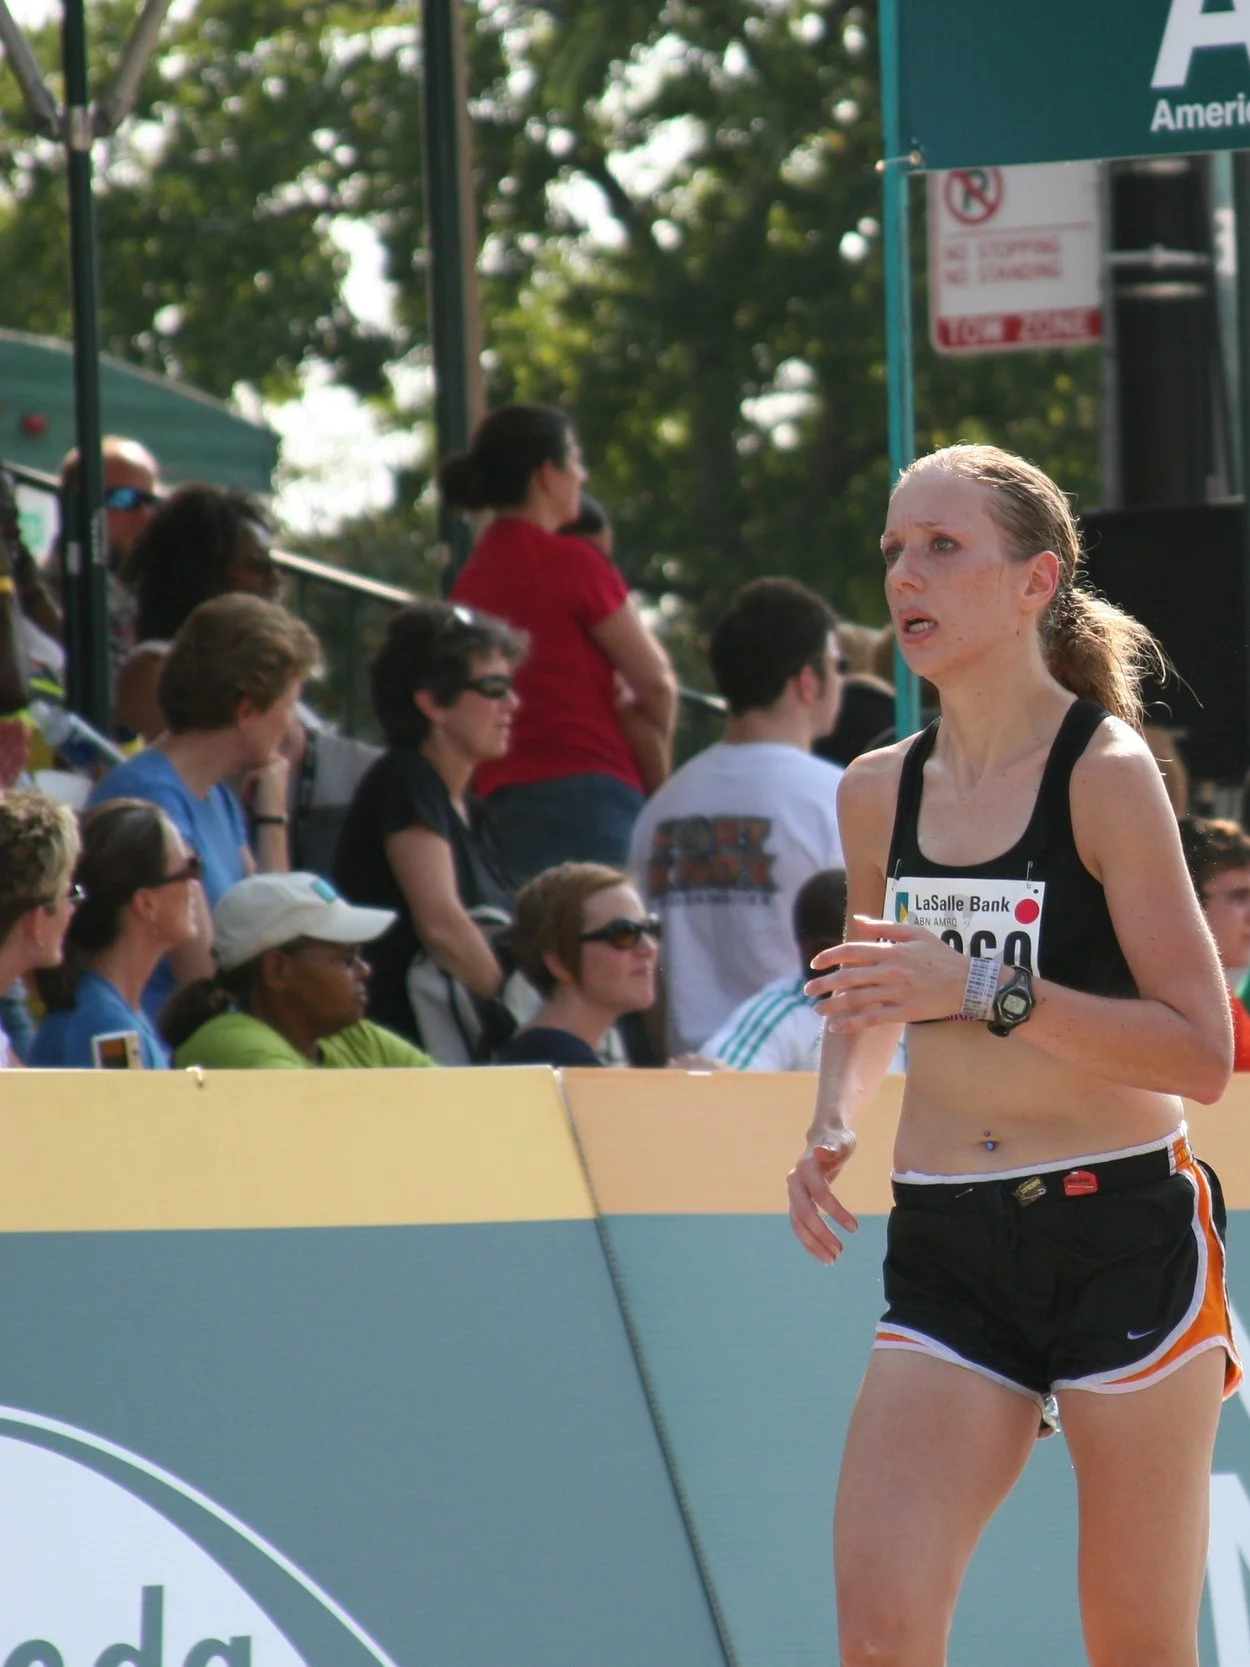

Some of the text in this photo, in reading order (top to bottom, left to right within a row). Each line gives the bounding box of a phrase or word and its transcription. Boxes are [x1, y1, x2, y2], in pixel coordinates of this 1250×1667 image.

[915, 894, 1011, 913] LaSalle Bank
[914, 917, 957, 927] ABN AMRO
